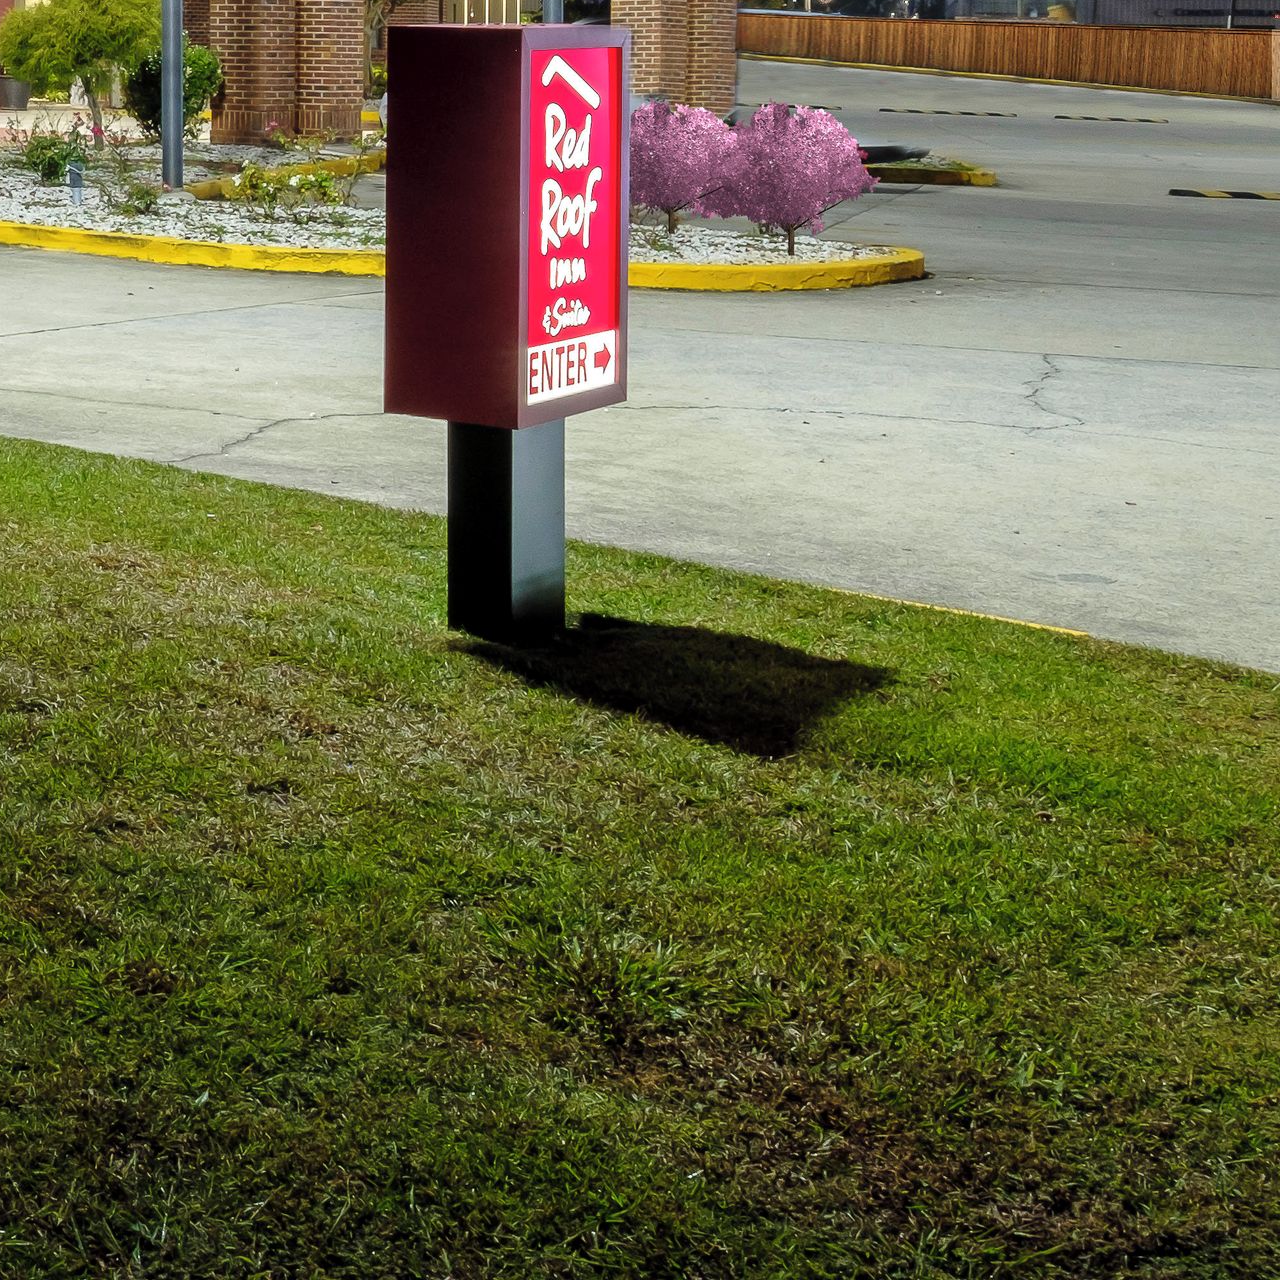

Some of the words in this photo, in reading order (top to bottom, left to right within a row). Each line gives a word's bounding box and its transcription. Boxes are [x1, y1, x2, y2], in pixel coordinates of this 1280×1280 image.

[545, 102, 592, 173] Red
[540, 166, 603, 256] Roof
[550, 257, 587, 290] Inn
[529, 341, 588, 396] ENTER
